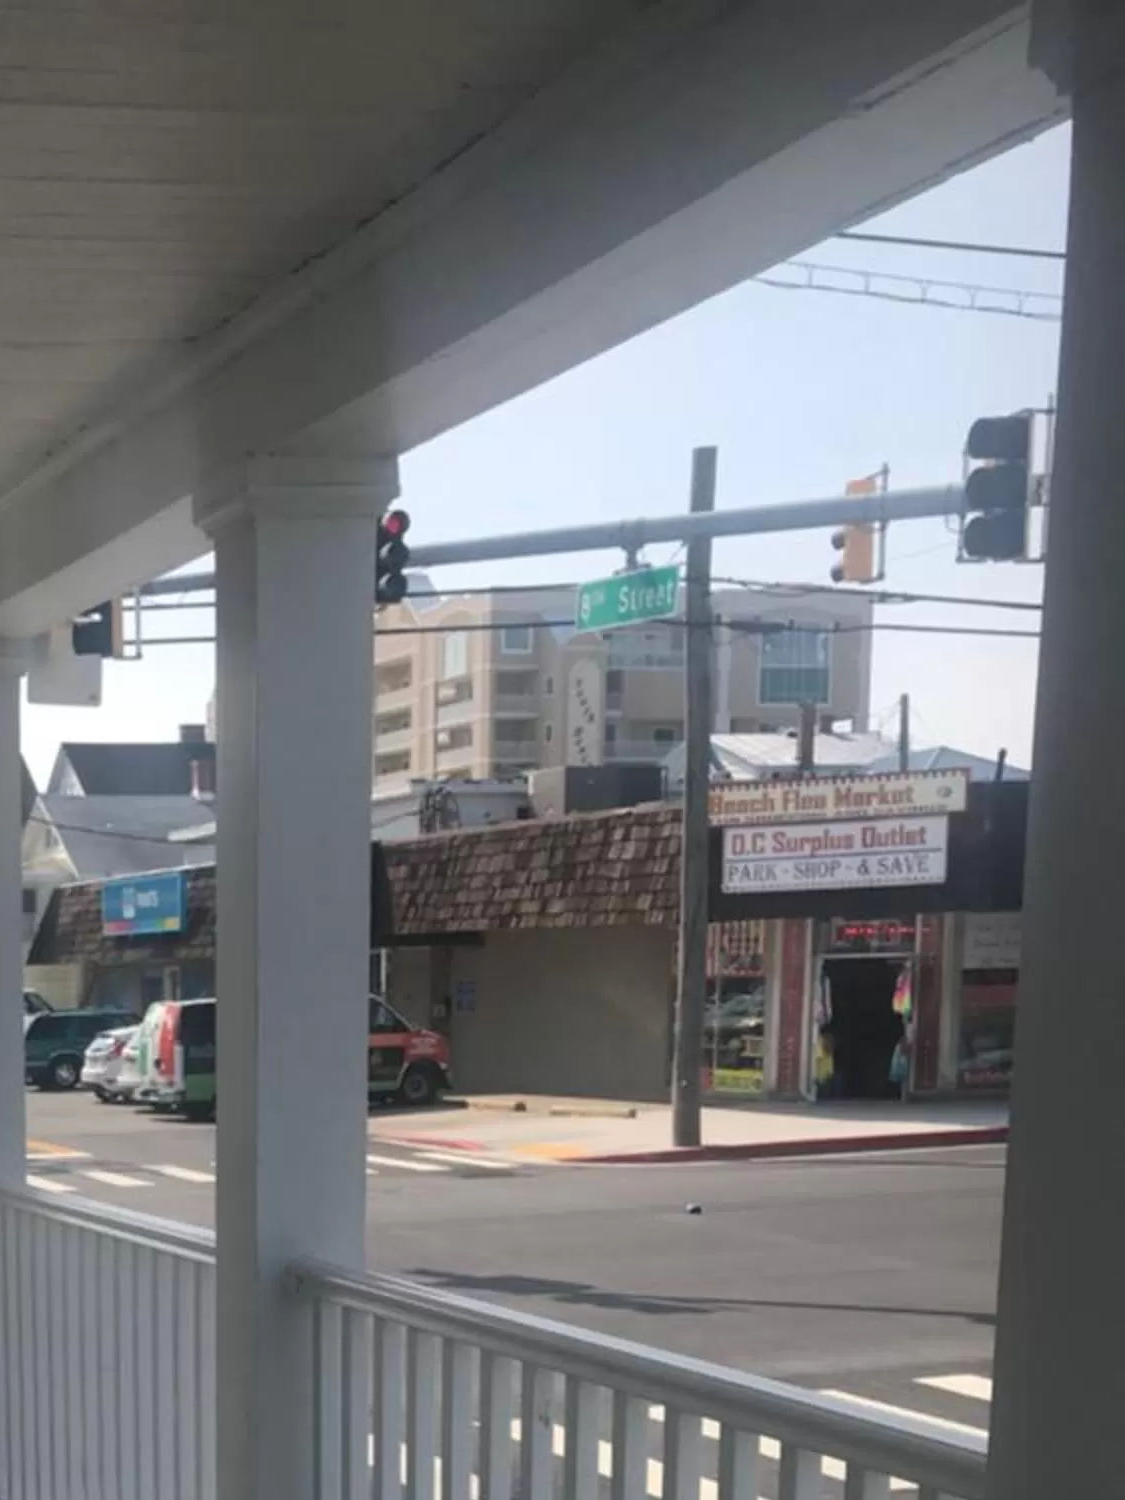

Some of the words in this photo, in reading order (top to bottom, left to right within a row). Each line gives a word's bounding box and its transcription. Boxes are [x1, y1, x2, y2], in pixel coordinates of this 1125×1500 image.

[618, 578, 675, 614] Street
[710, 791, 775, 815] Beach
[782, 789, 828, 812] Flea
[835, 784, 915, 808] Market
[773, 828, 854, 857] Surplus
[861, 824, 928, 850] Outlet
[727, 861, 778, 883] PARK
[794, 859, 842, 880] SHOP
[877, 853, 929, 875] SAVE
